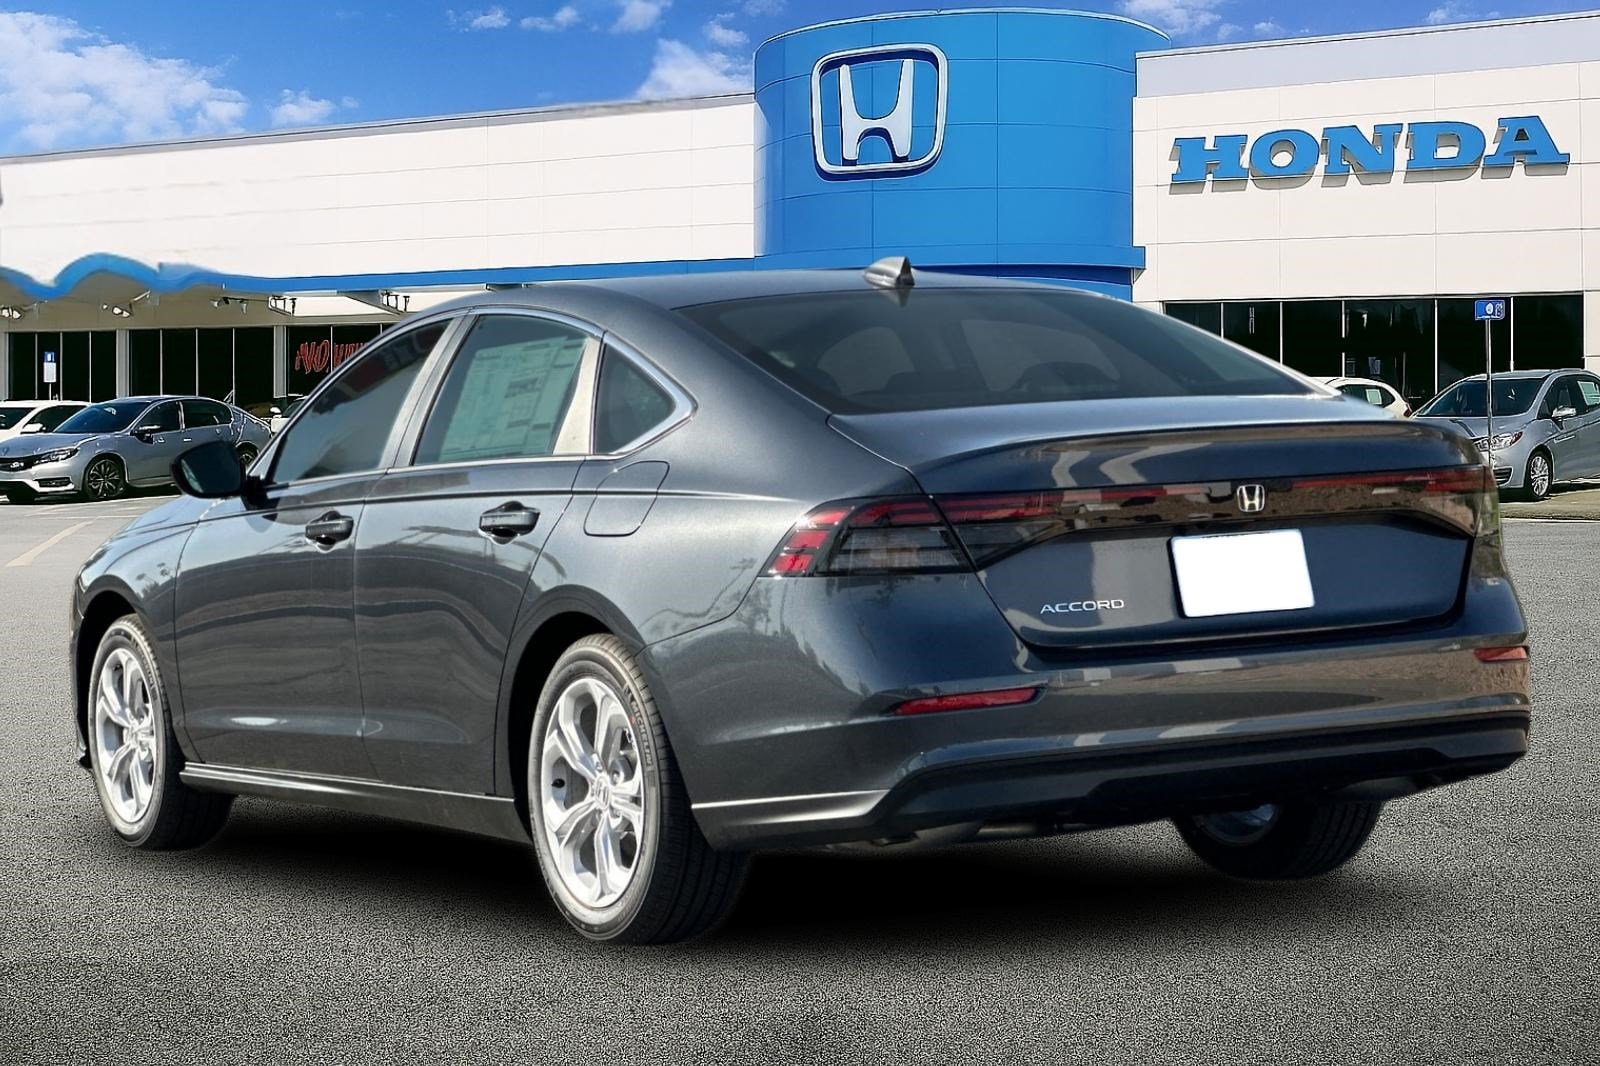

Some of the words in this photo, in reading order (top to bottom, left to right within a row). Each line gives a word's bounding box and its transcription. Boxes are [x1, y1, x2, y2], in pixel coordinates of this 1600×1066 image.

[1171, 115, 1570, 183] HONDA
[1040, 599, 1125, 614] ACCORD
[630, 700, 652, 765] MICHELIN
